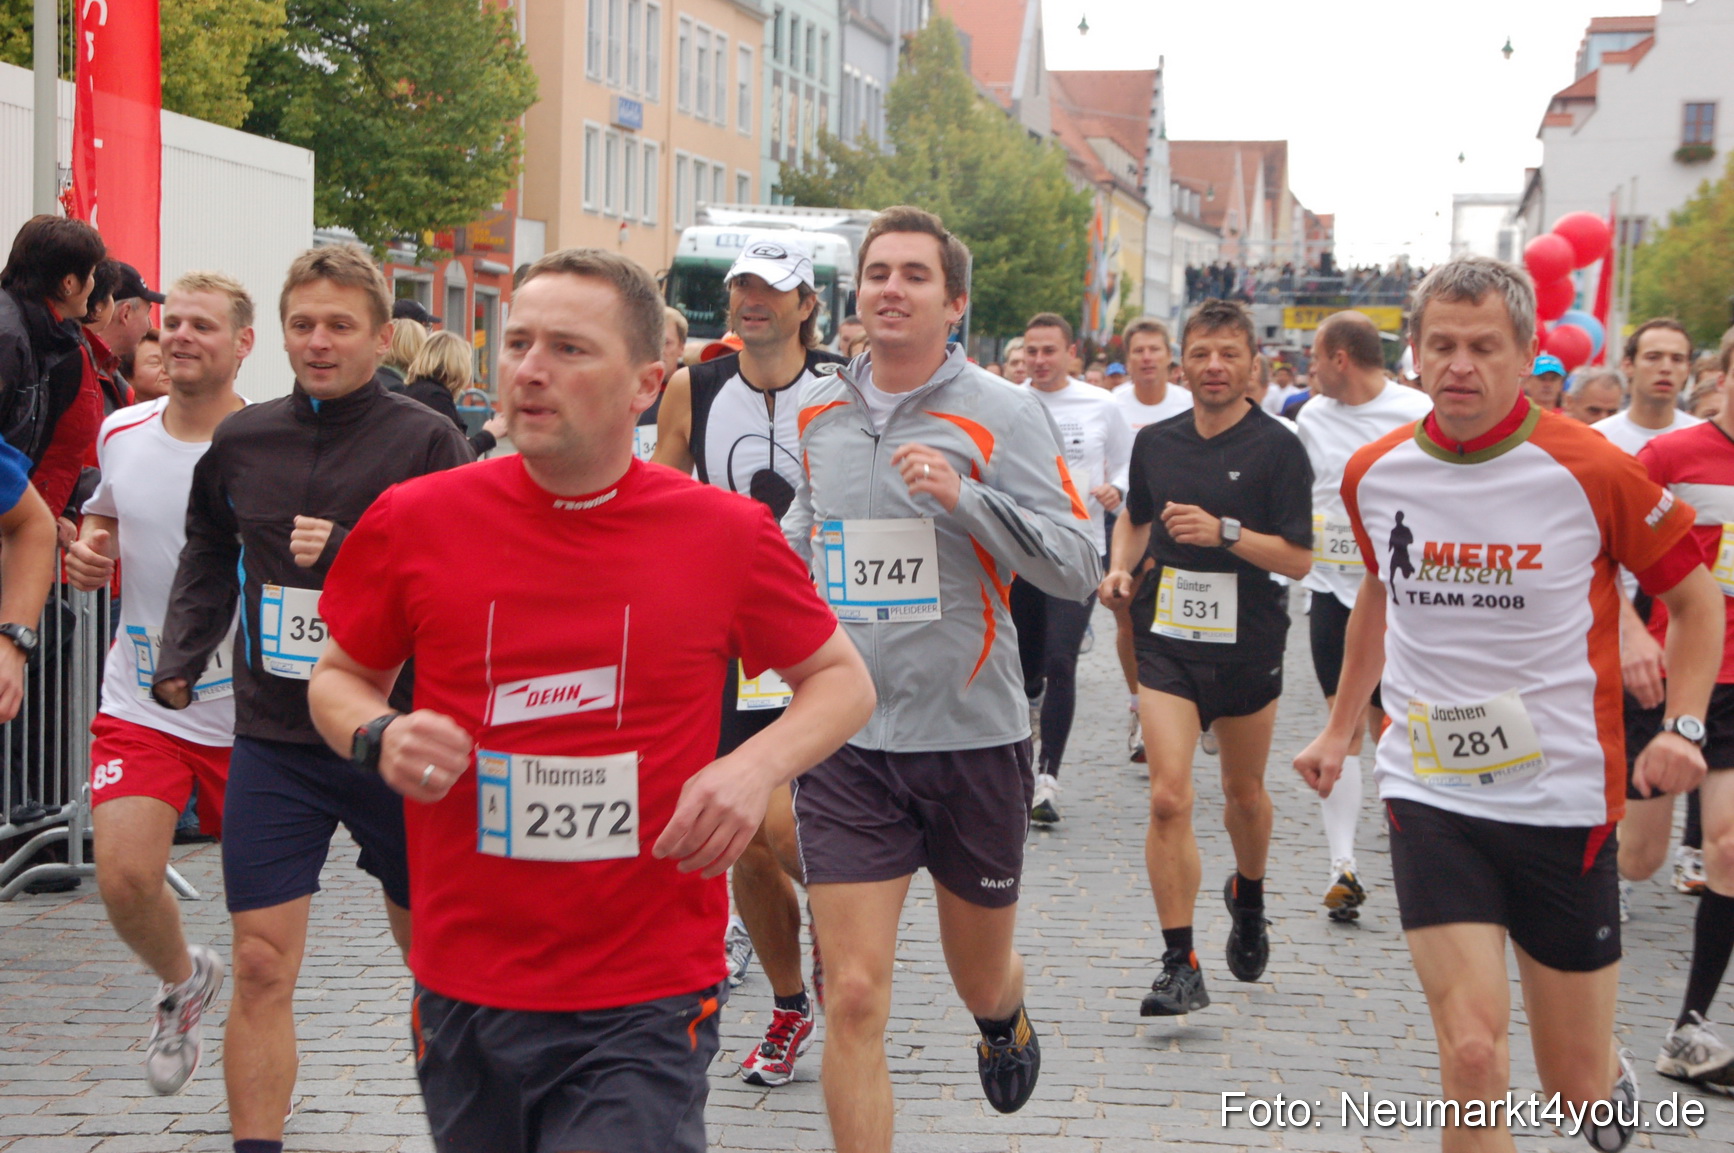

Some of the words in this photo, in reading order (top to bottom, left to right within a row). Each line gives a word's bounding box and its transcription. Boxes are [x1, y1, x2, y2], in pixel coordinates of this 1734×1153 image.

[1423, 541, 1543, 570] MERZ
[854, 558, 924, 586] 3747
[1416, 559, 1514, 586] Reisen
[1183, 599, 1219, 620] 531
[1406, 590, 1465, 607] TEAM
[1472, 594, 1526, 610] 2008
[290, 615, 332, 643] 35
[525, 683, 583, 708] DEHN
[1432, 704, 1487, 722] Jochen
[1448, 725, 1508, 758] 281
[93, 758, 124, 790] 85
[522, 758, 607, 786] Thomas
[525, 800, 633, 839] 2372
[980, 877, 1015, 889] JAKO
